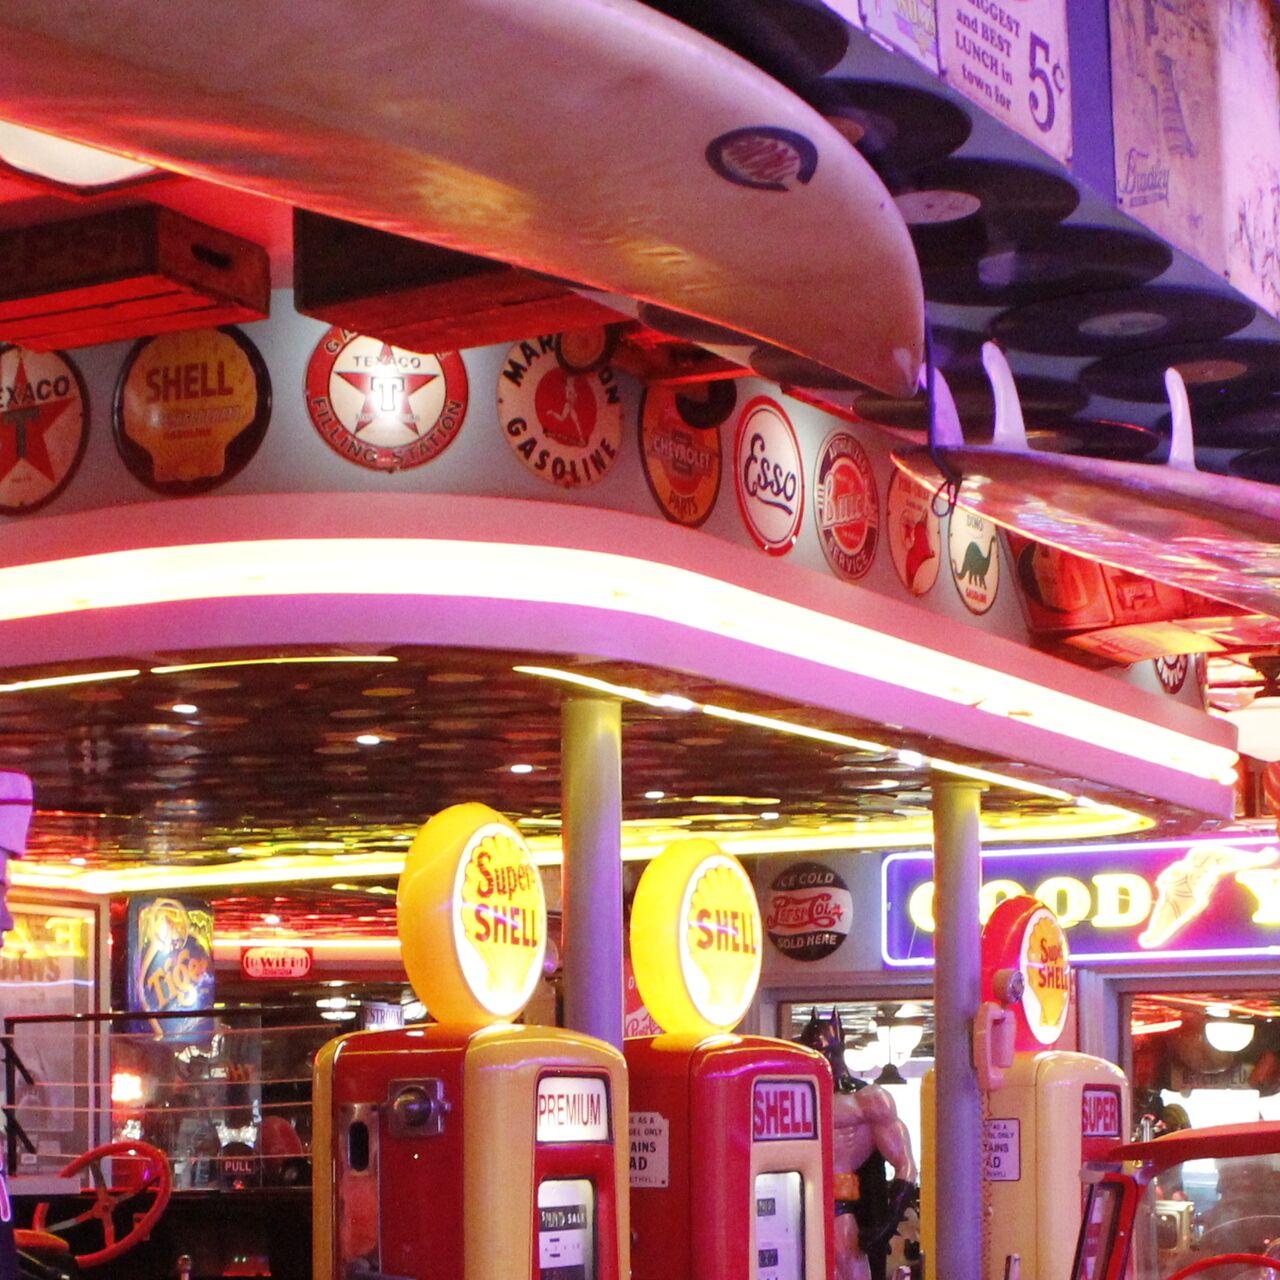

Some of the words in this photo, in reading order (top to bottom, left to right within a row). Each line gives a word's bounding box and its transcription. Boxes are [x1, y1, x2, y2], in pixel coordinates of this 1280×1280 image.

[957, 8, 978, 34] and
[981, 27, 1011, 57] BEST
[955, 30, 999, 76] LUNCH
[1001, 64, 1012, 85] in
[962, 64, 992, 96] town
[995, 84, 1011, 111] for
[354, 353, 421, 369] TEXACO
[503, 334, 619, 404] MARON
[146, 360, 234, 406] SHELL
[312, 396, 378, 464] FILLING
[391, 400, 462, 465] STATION
[506, 416, 616, 486] GASOLINE
[743, 432, 797, 502] Esso
[668, 490, 699, 517] PARTS
[826, 538, 870, 573] SERVICE
[777, 873, 799, 889] ICE
[801, 871, 834, 887] COLD
[474, 903, 539, 948] SHELL
[695, 908, 758, 955] SHELL
[777, 935, 805, 950] SOLD
[807, 933, 838, 948] HERE
[1039, 965, 1069, 992] SHELL
[538, 1093, 601, 1129] PREMIUM
[753, 1090, 812, 1135] SHELL
[1082, 1096, 1118, 1134] SUPER
[629, 1156, 648, 1171] AD
[630, 1141, 657, 1153] AINS
[983, 1143, 1009, 1153] TAINS
[225, 1160, 251, 1173] PULL
